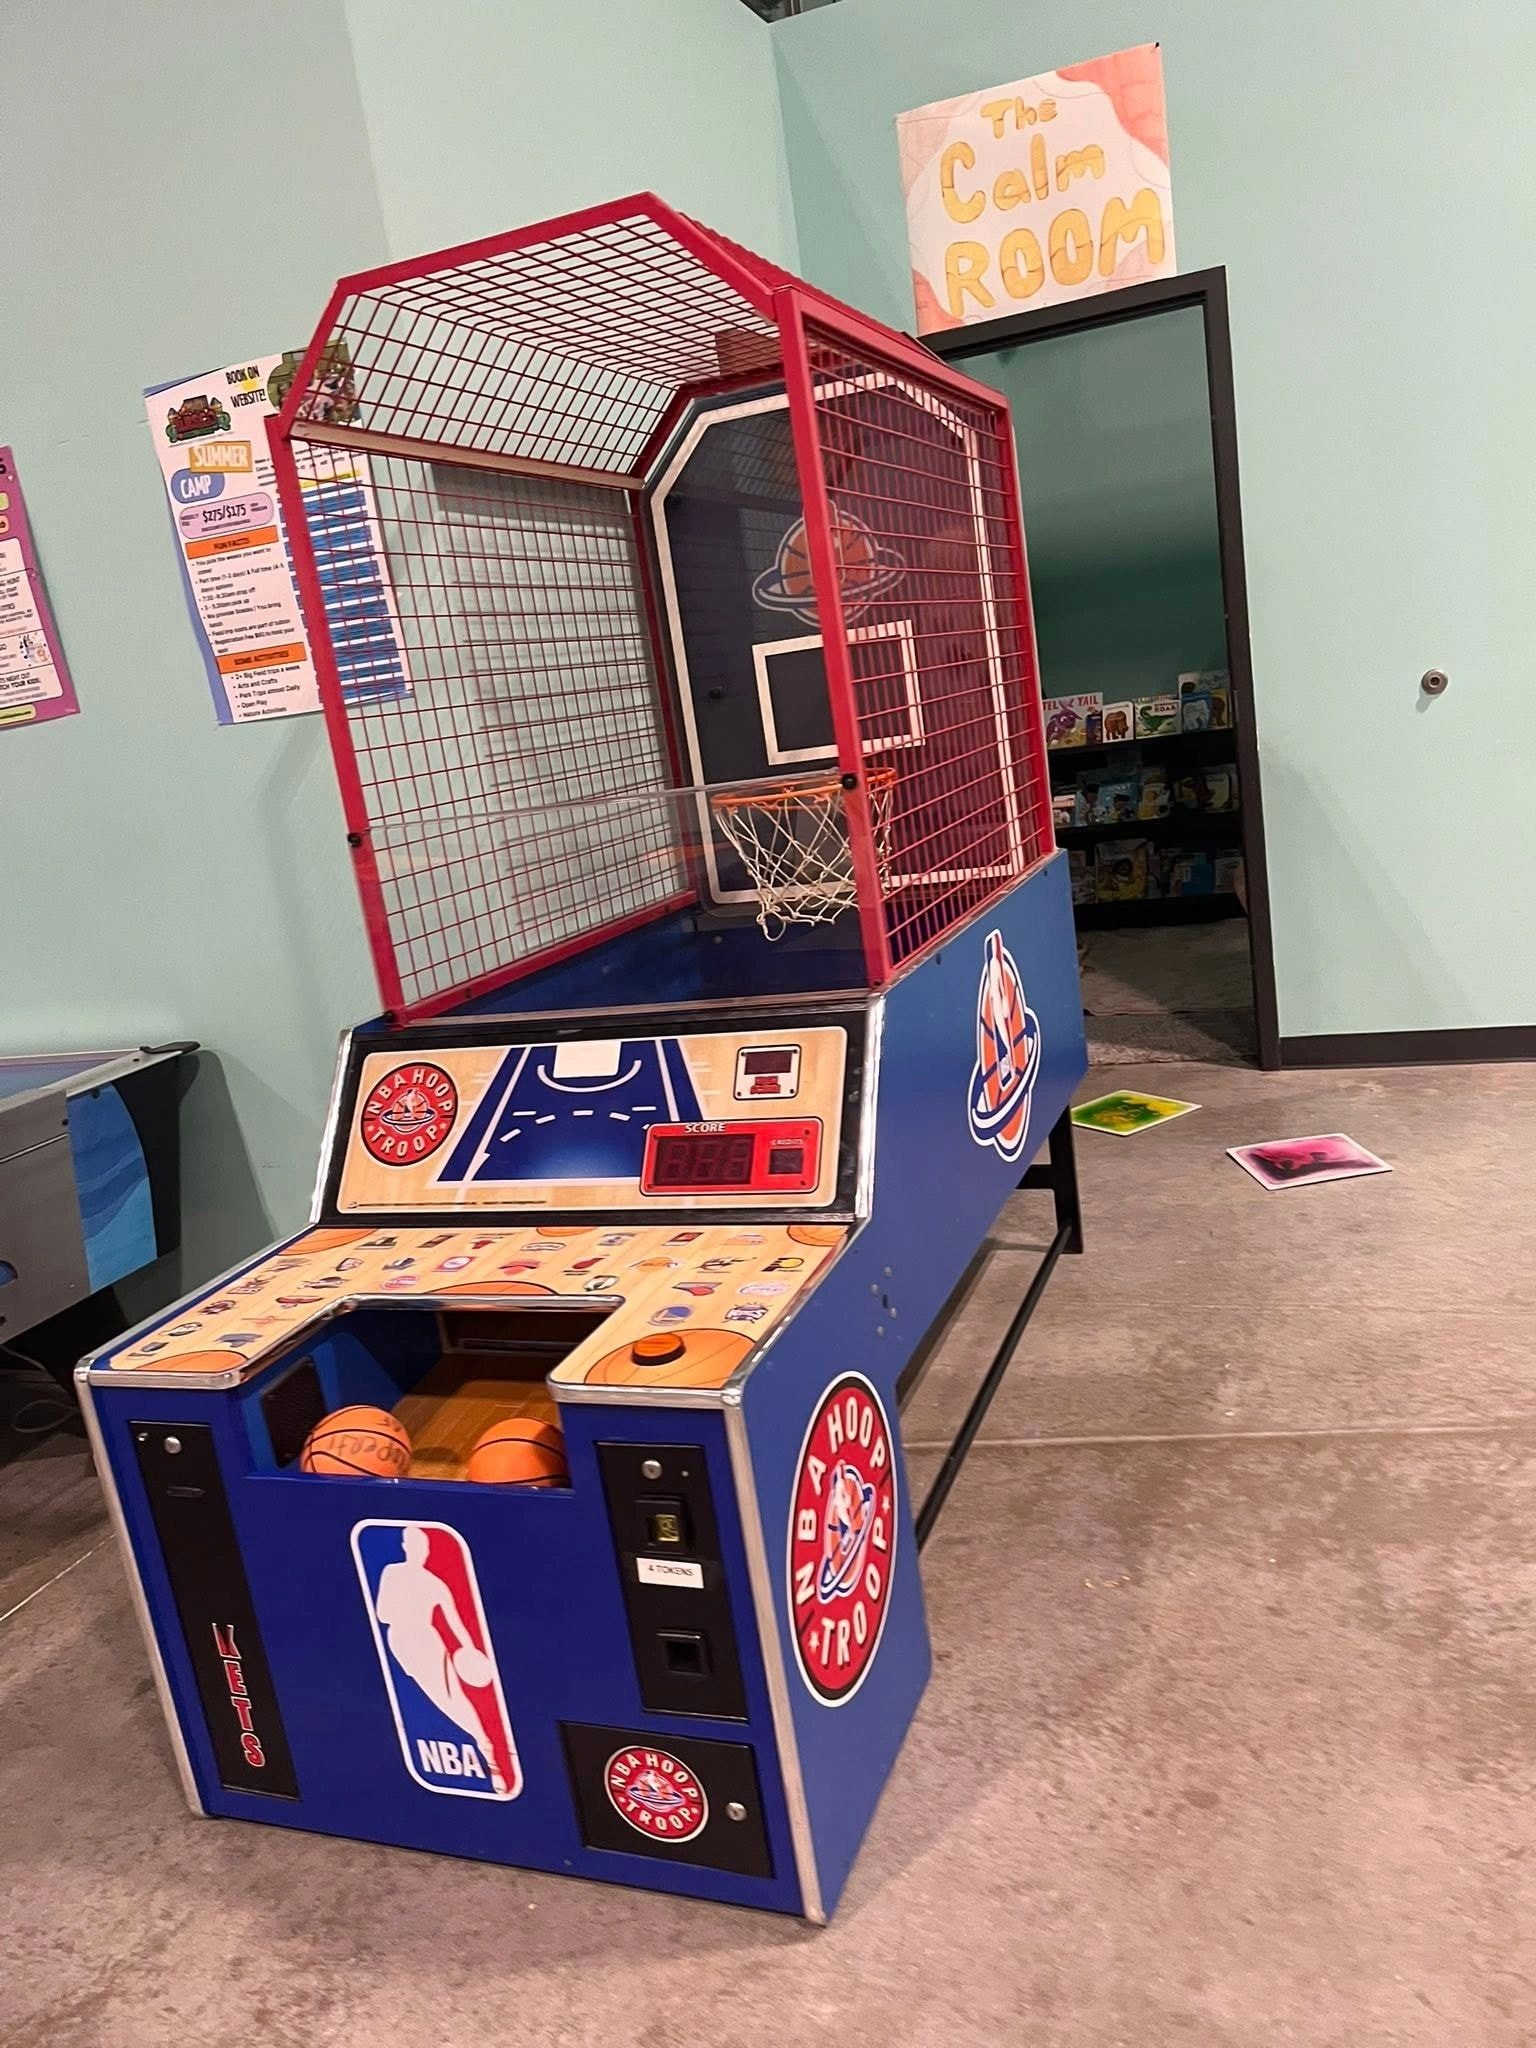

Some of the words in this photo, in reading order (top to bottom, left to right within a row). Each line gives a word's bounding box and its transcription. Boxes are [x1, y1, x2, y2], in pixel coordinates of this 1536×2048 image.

[980, 96, 1058, 139] The
[940, 133, 1106, 224] Calm
[945, 188, 1165, 317] ROOM
[226, 368, 248, 385] BOOK
[247, 365, 260, 379] ON
[192, 445, 249, 468] SUMMER
[181, 475, 211, 499] CAMP
[203, 504, 246, 523] $275/$175
[367, 1073, 407, 1114] NBA
[412, 1068, 454, 1111] HOOP
[371, 1125, 439, 1156] TROOP
[684, 1122, 726, 1133] SCORE
[795, 1454, 827, 1606] NBA
[827, 1396, 885, 1470] HOOP
[656, 1565, 695, 1576] TOKENS
[820, 1517, 888, 1667] TROOP
[416, 1738, 486, 1779] NBA
[610, 1753, 642, 1788] NBA
[645, 1752, 698, 1798] HOOP
[626, 1799, 693, 1831] TROOP
